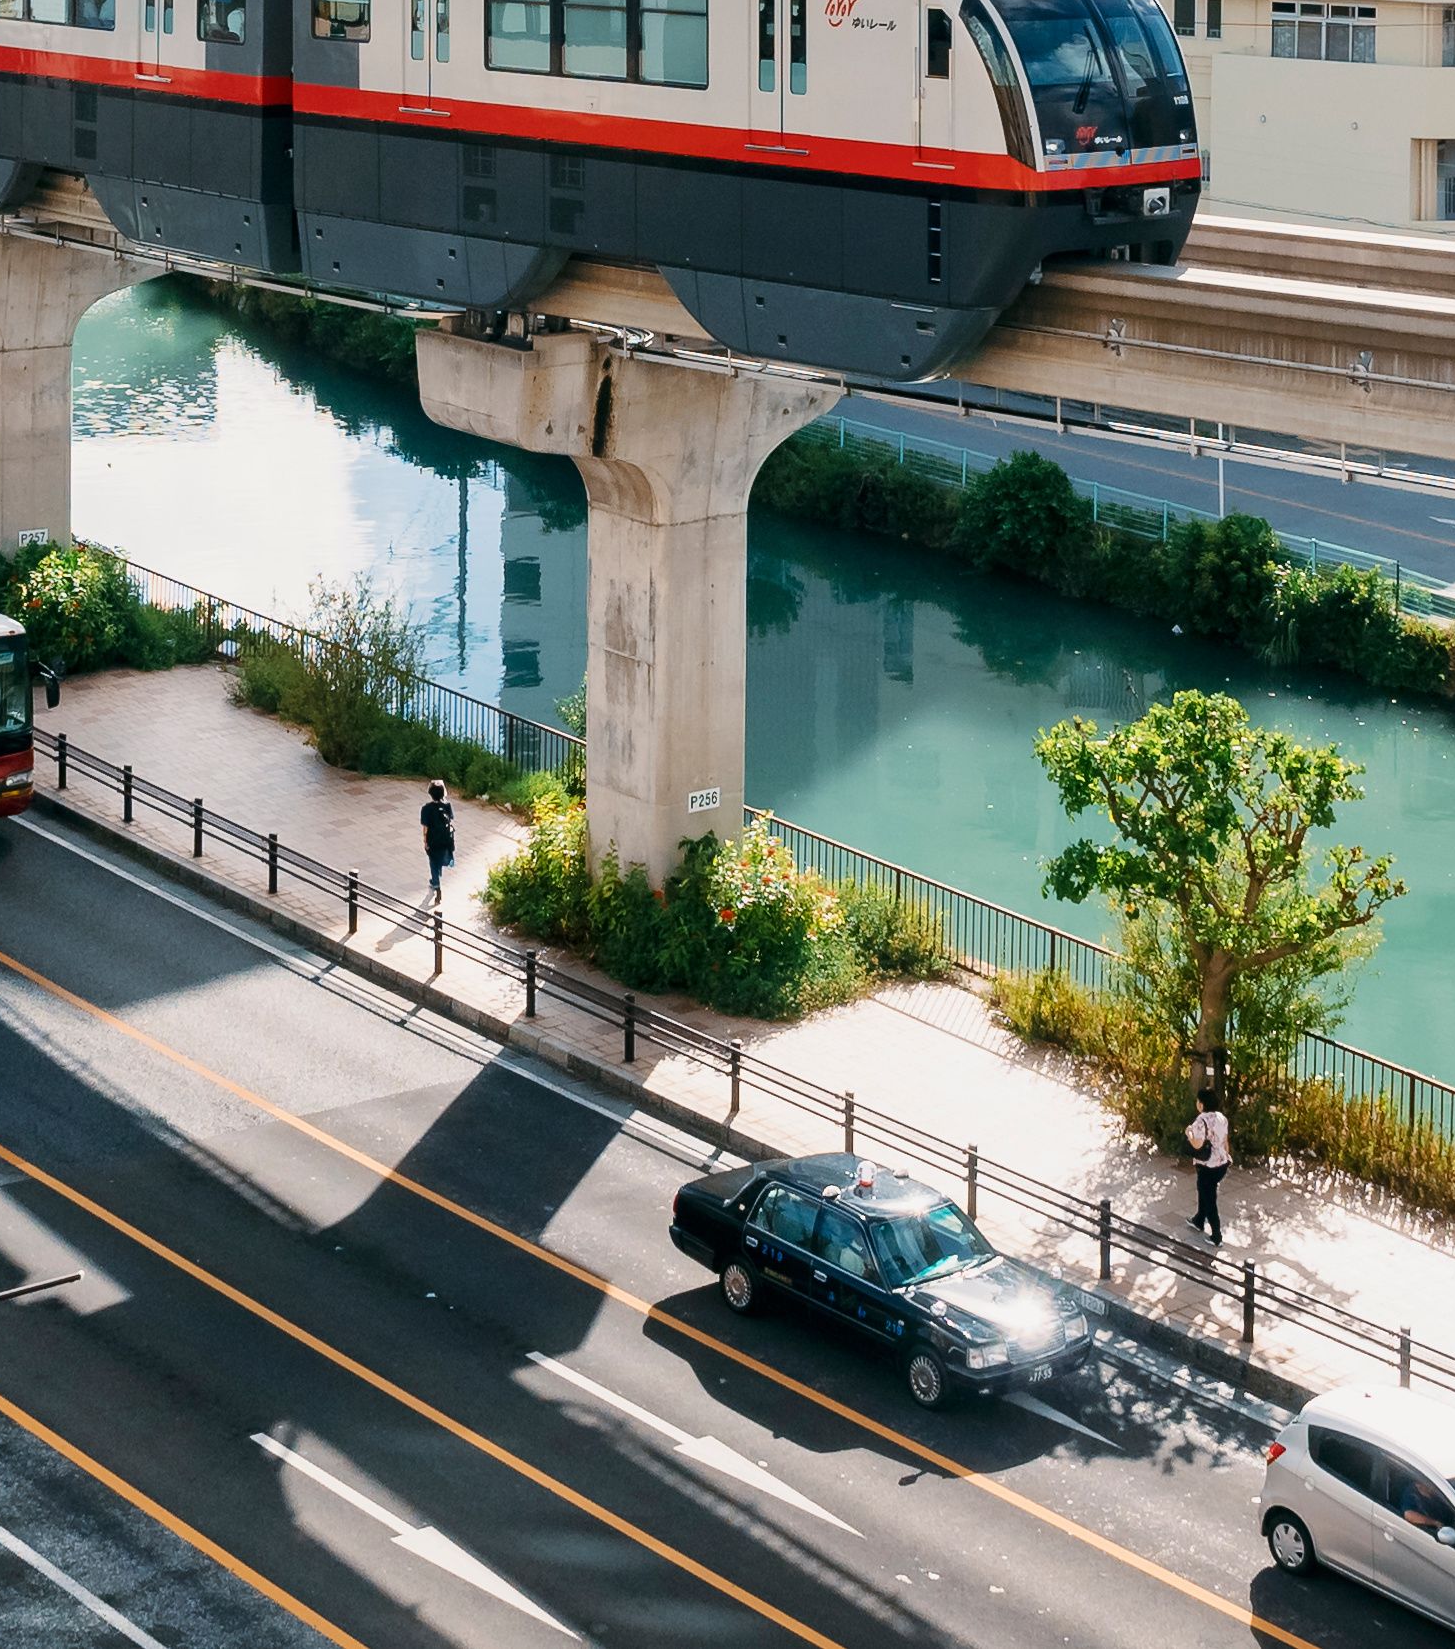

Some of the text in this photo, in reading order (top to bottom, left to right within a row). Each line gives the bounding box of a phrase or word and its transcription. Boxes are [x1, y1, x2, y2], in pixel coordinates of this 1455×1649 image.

[851, 17, 897, 31] ゆいレール
[20, 531, 46, 544] P257
[690, 790, 719, 810] P256
